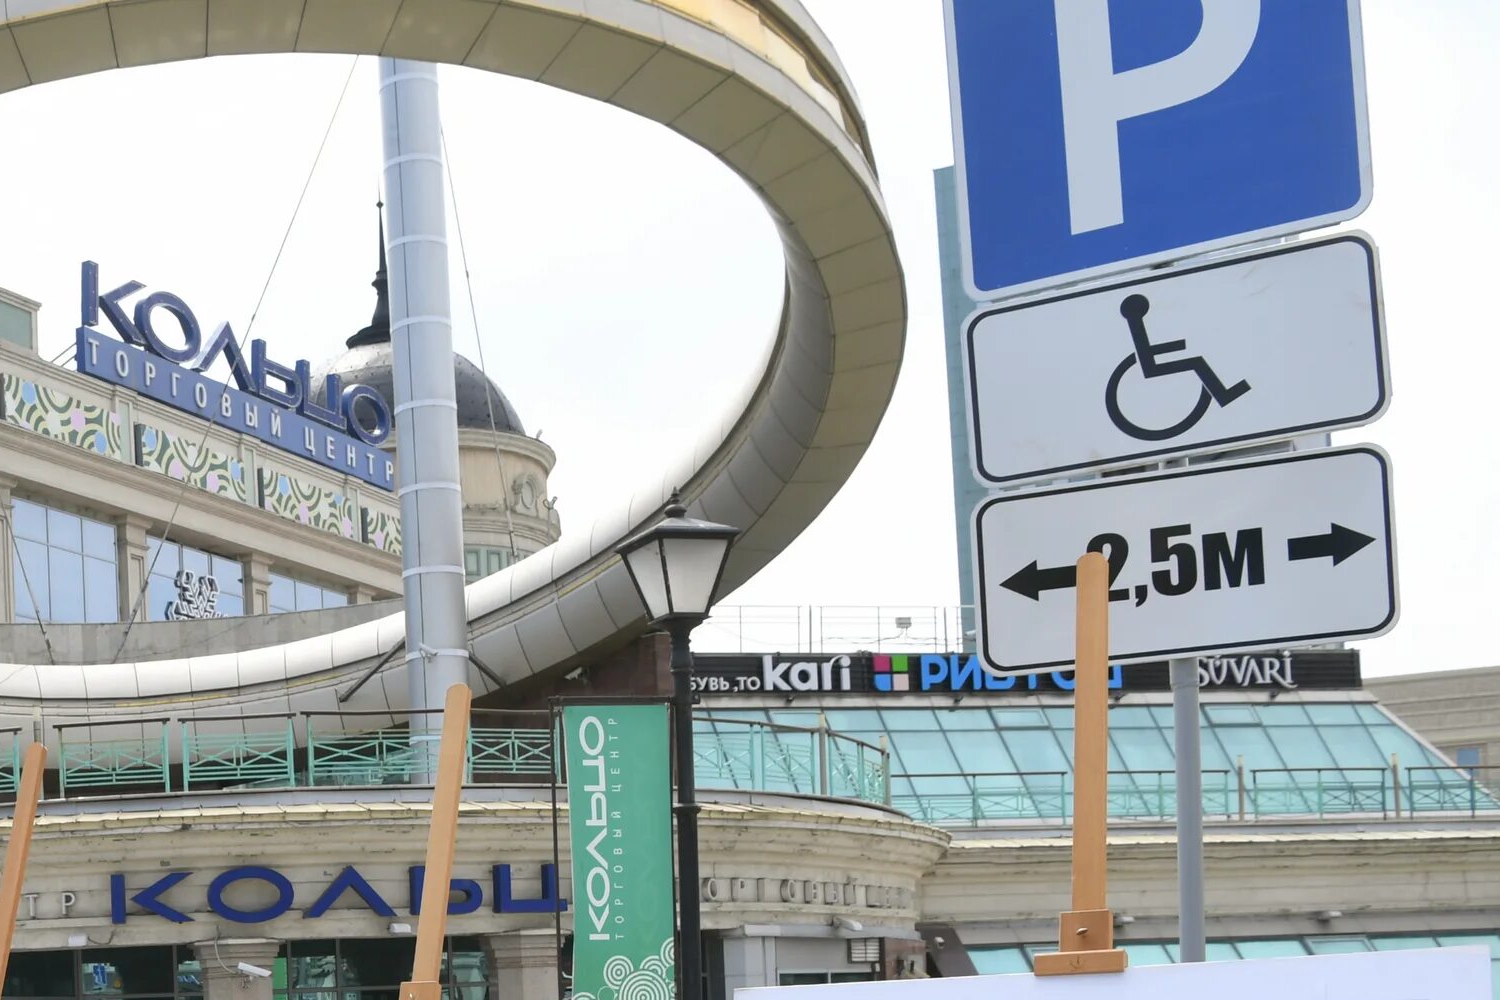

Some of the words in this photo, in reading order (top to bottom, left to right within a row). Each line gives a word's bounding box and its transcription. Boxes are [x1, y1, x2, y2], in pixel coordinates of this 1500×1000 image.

[1055, 0, 1261, 236] P
[81, 260, 392, 447] КОЛЬЦО
[87, 336, 283, 439] ТОРГОВЫЙ
[304, 425, 395, 483] ЦЕНТР
[690, 676, 730, 691] БУВЬ
[762, 655, 852, 691] kari
[607, 717, 623, 793] ЦЕНТР
[110, 863, 568, 924] КОЛЬЦ
[579, 715, 611, 941] КОЛЬЦО
[610, 811, 625, 941] ТОРГОВЫЙ
